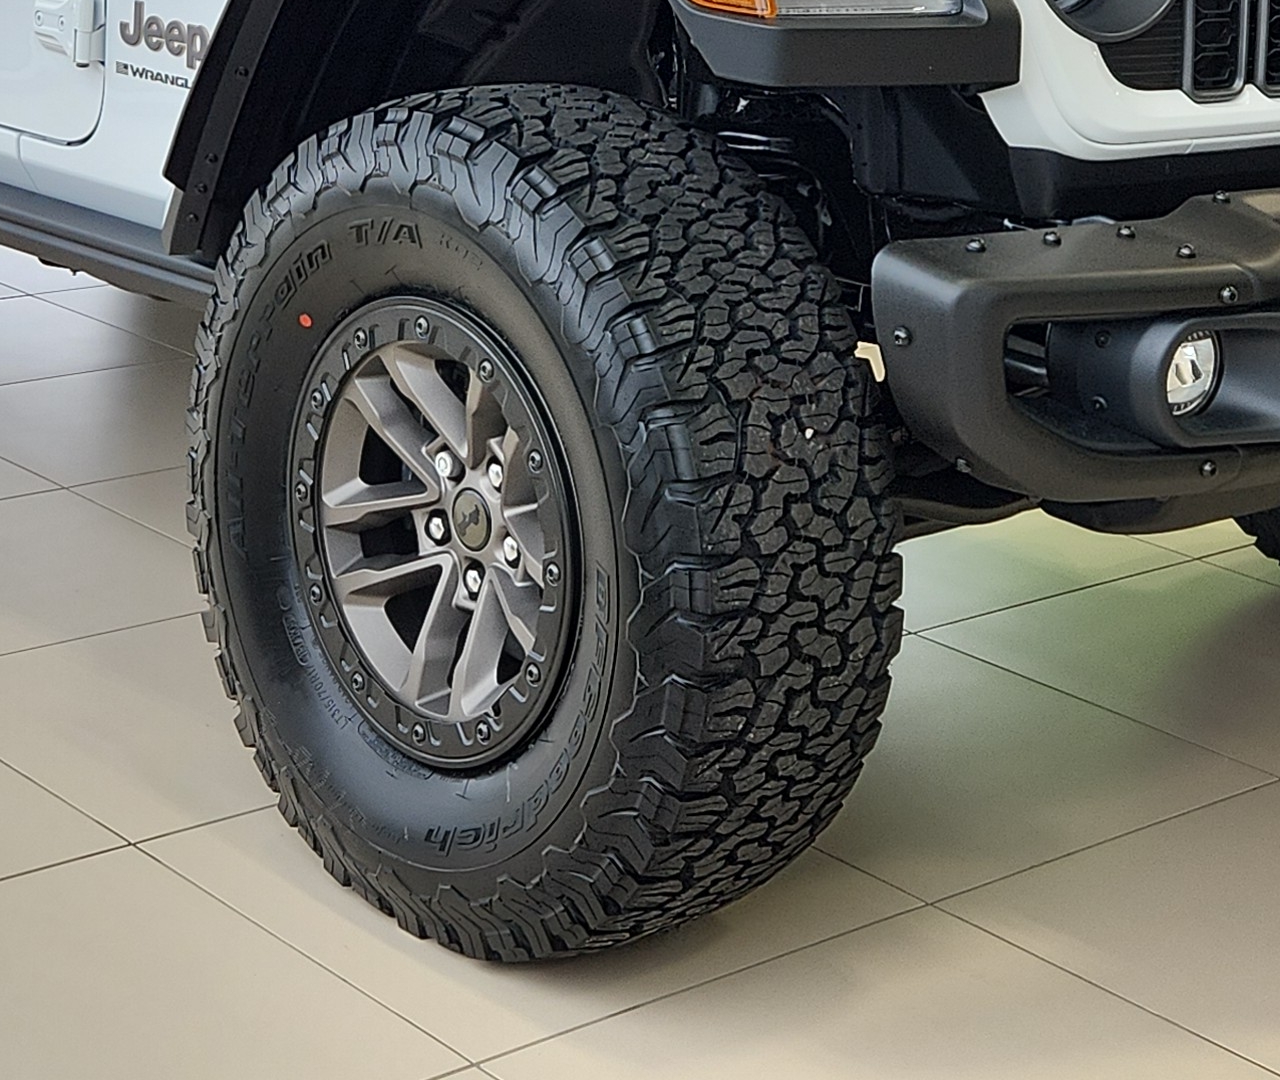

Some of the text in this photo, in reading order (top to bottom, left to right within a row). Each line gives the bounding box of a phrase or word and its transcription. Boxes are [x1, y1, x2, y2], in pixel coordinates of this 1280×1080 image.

[119, 0, 210, 70] Jeep
[130, 64, 192, 89] WRANGL
[347, 216, 424, 249] T/A
[423, 560, 615, 858] BFGoodrich
